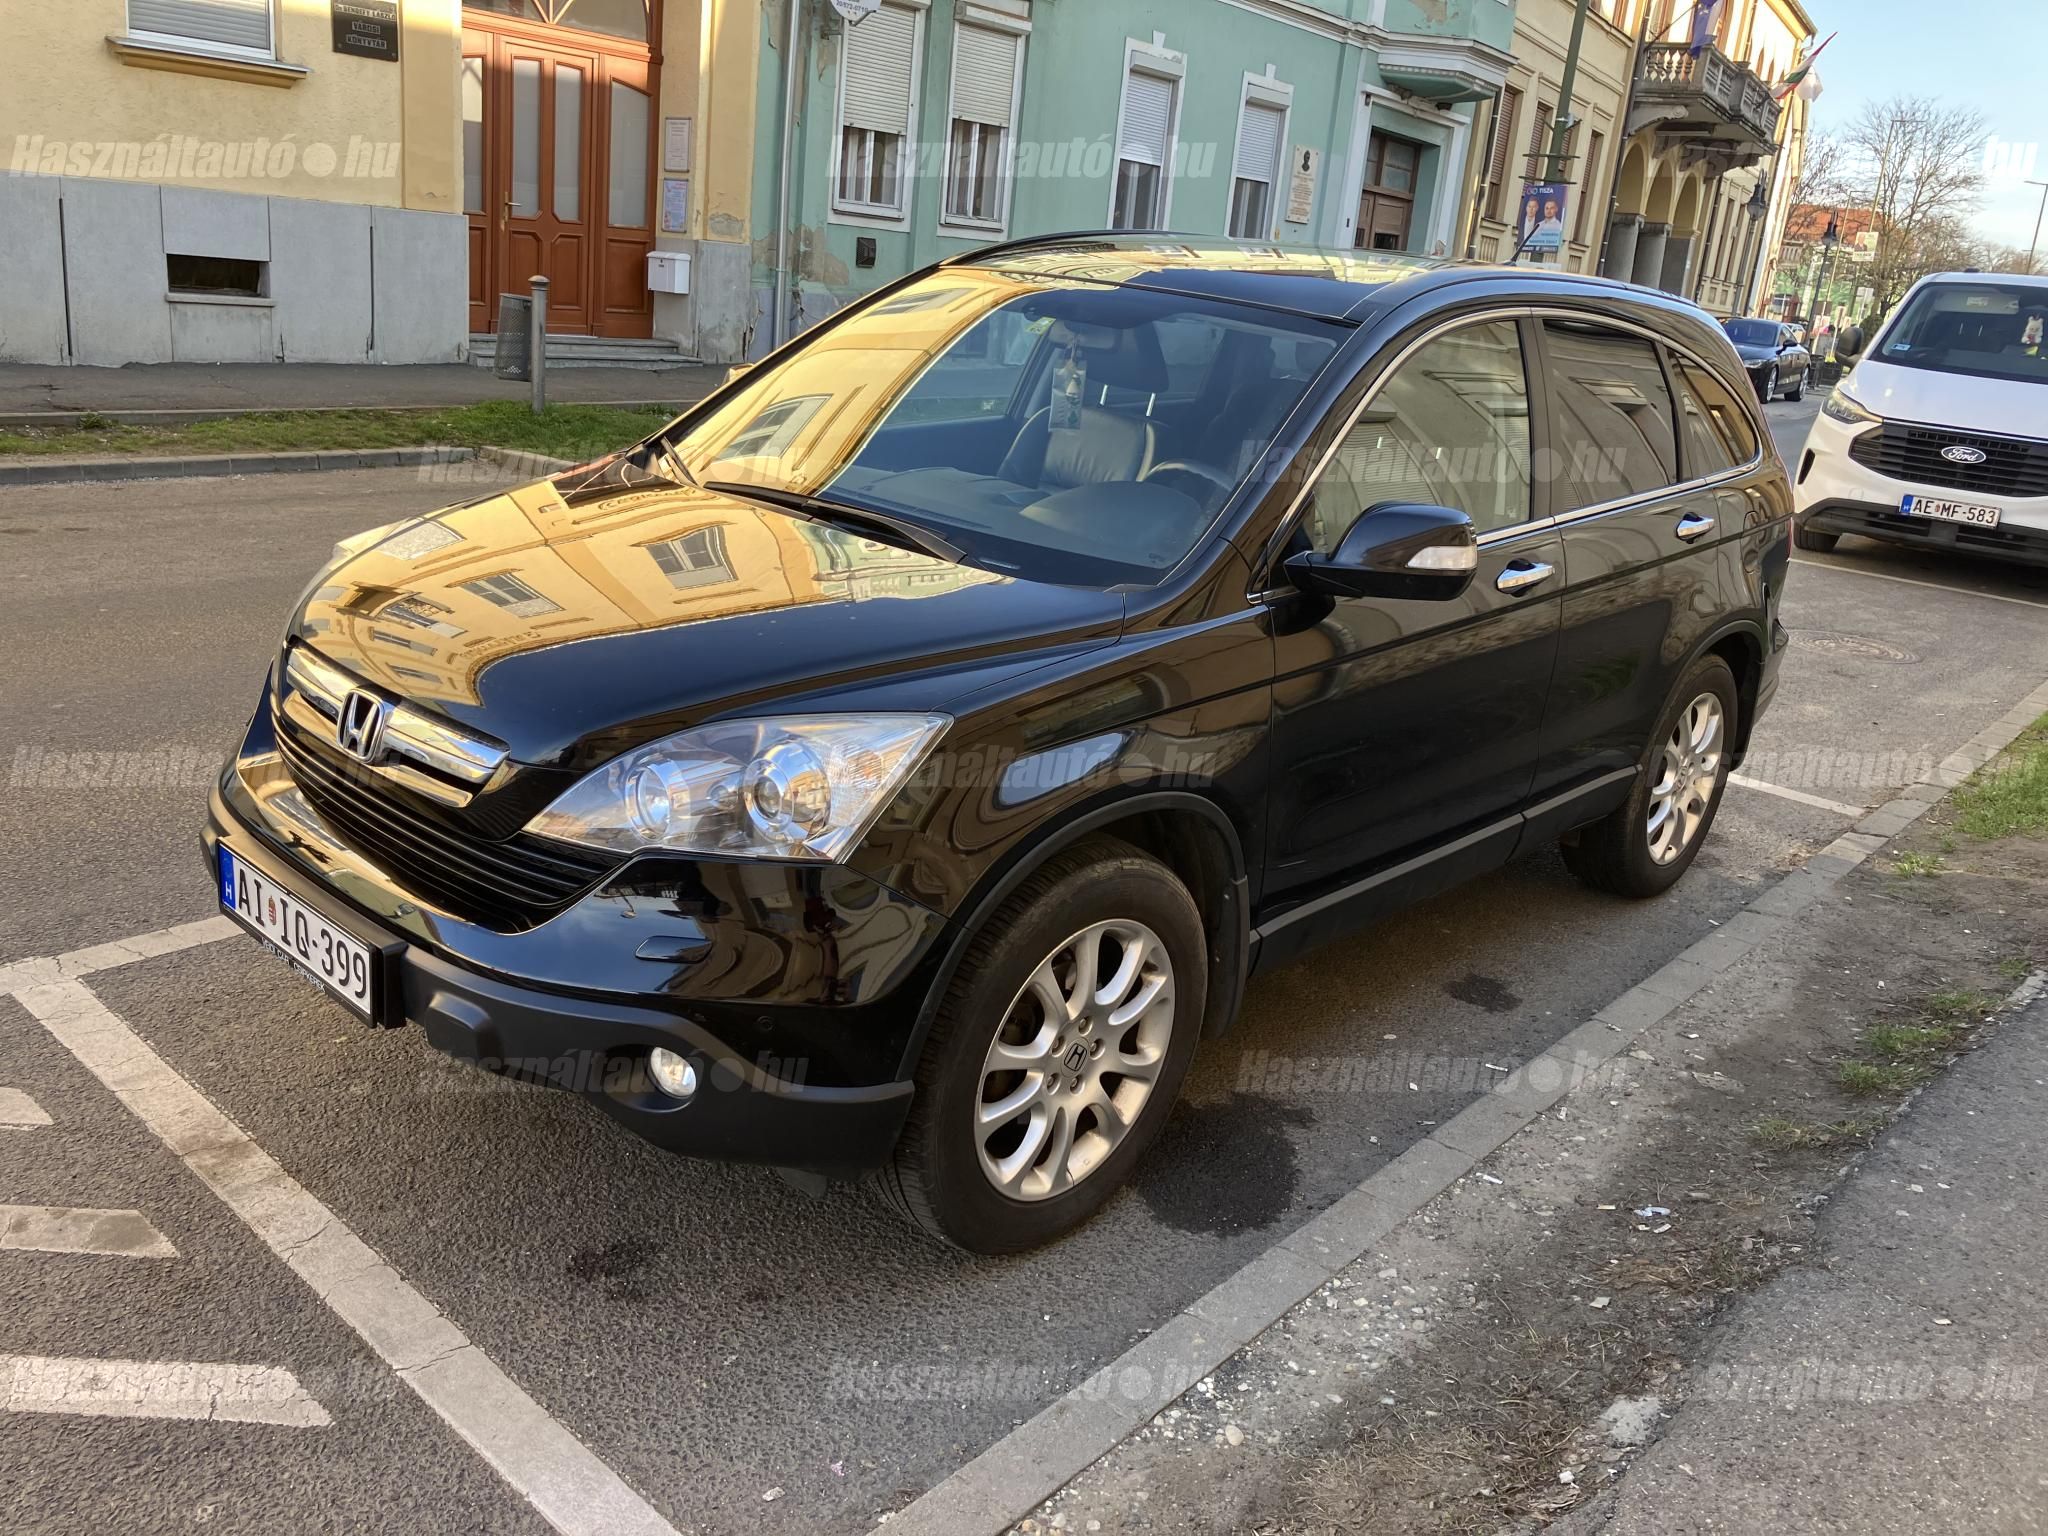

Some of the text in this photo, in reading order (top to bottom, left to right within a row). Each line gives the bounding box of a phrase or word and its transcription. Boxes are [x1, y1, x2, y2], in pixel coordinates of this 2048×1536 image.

[352, 21, 380, 34] VÁROSI
[346, 34, 387, 49] KÖNYVTÁR
[1947, 448, 1979, 461] Ford
[1912, 499, 1935, 515] AE
[1939, 503, 1997, 524] MF-583
[224, 867, 368, 1000] H AI IQ-399
